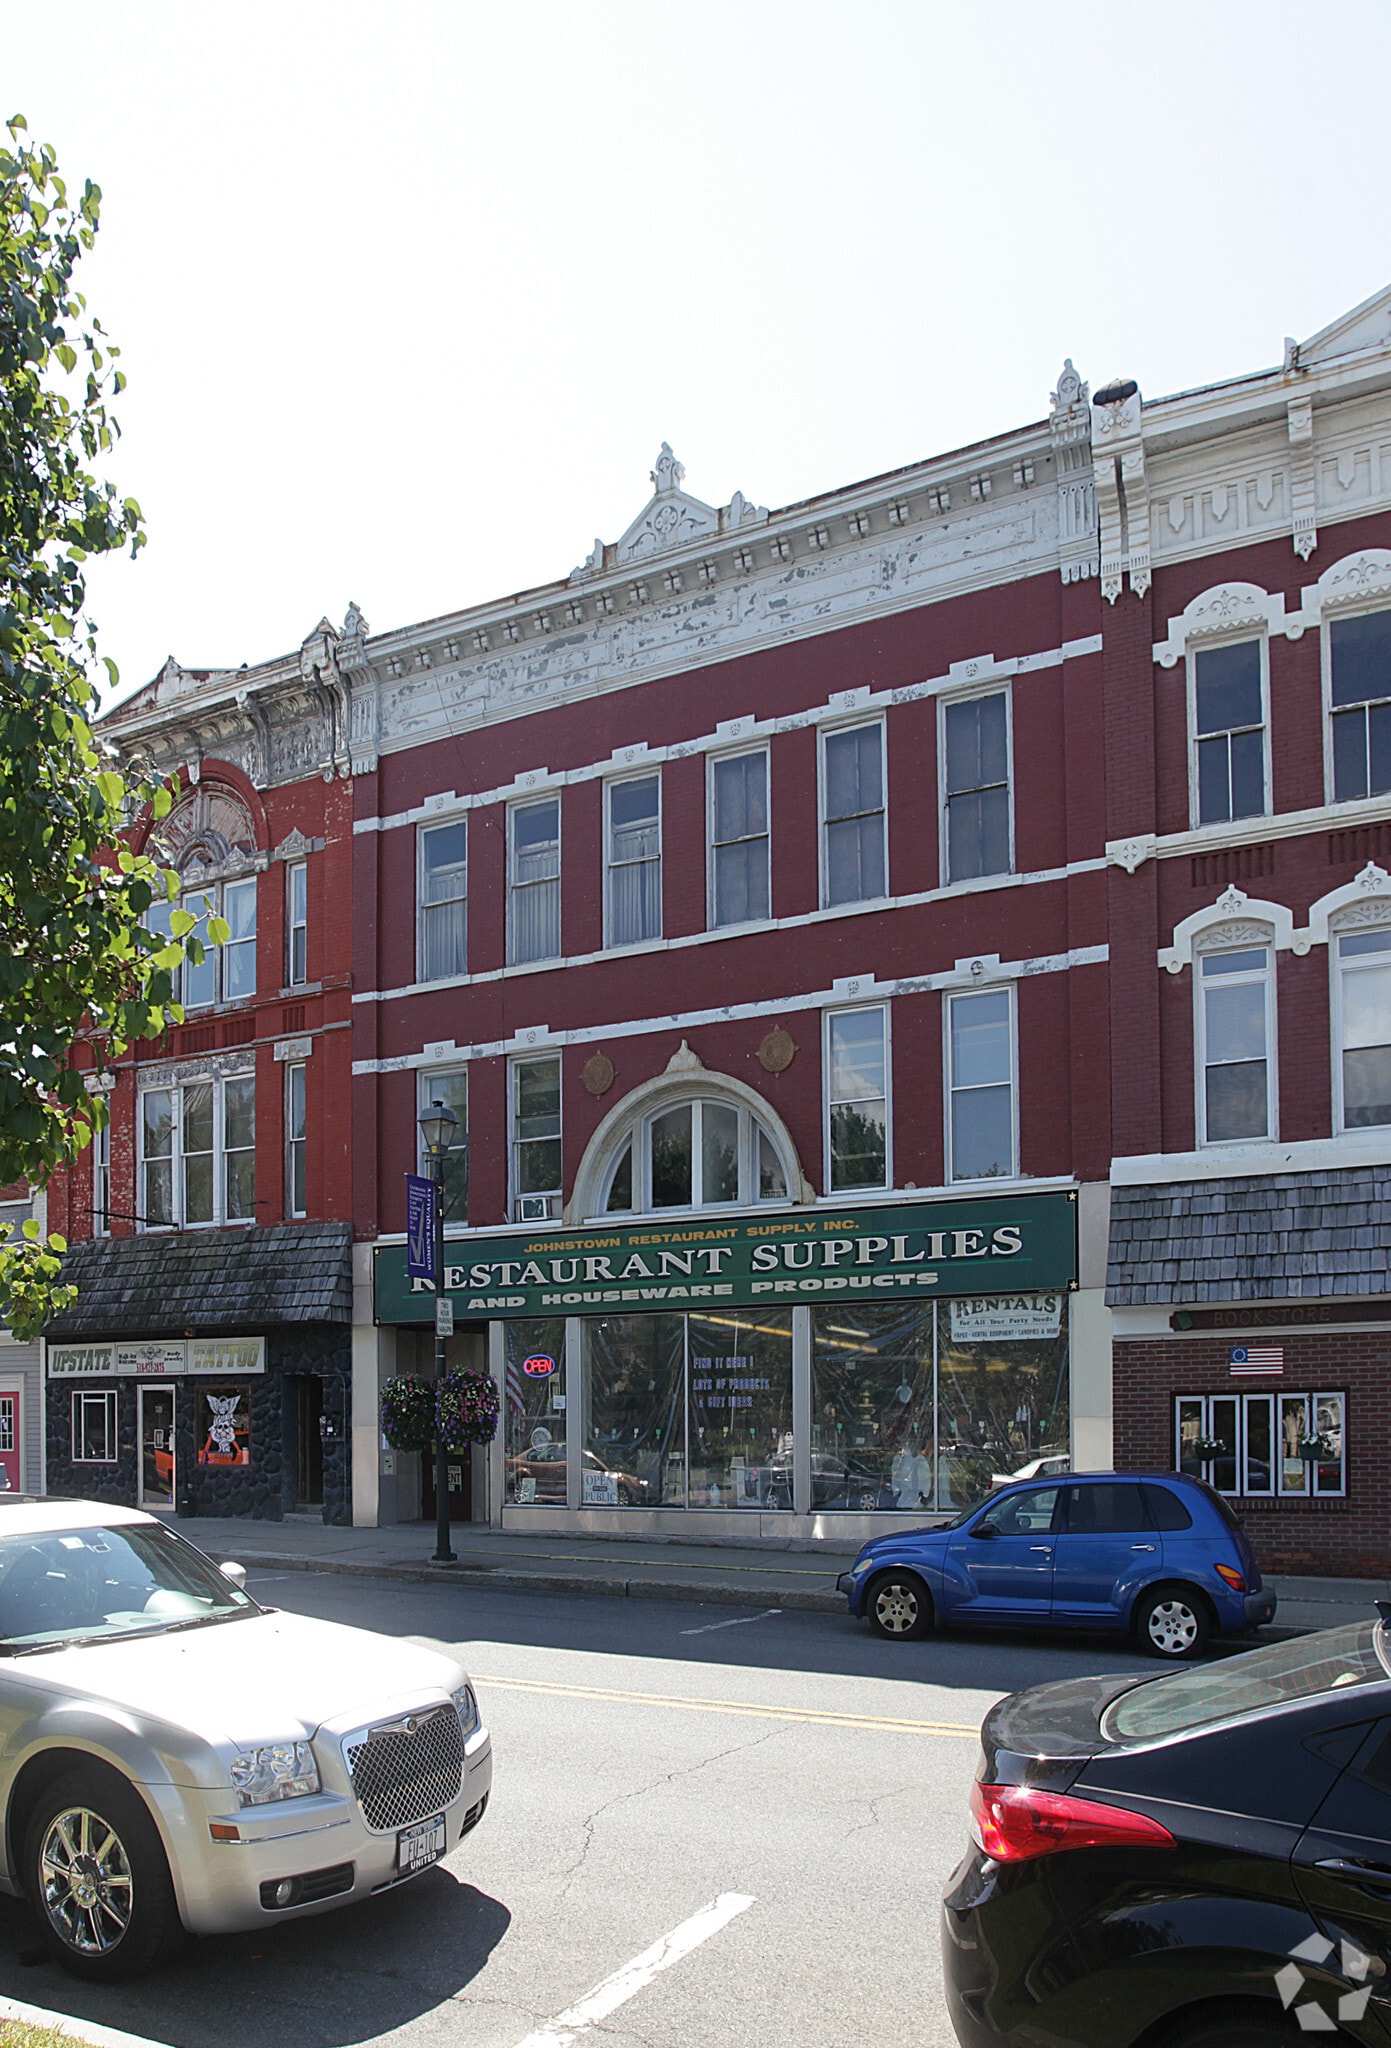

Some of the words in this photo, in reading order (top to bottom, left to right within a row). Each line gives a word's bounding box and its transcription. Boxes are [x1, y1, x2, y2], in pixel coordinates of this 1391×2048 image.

[524, 1238, 621, 1253] JOHNSTOWN
[629, 1229, 739, 1245] RESTAURANT
[746, 1223, 816, 1237] SUPPLY,
[824, 1219, 860, 1231] INC.
[425, 1232, 433, 1271] WOMEN'S
[751, 1226, 1023, 1271] SUPPLIES
[467, 1295, 526, 1310] AND
[542, 1284, 733, 1305] HOUSEWARE
[751, 1272, 939, 1294] PRODUCTS
[955, 1296, 1057, 1319] RENTALS
[1214, 1306, 1331, 1327] BOOKSTORE
[52, 1348, 112, 1372] UPSTATE
[193, 1344, 260, 1369] TATTOO
[525, 1359, 553, 1374] OPEN
[693, 1357, 712, 1369] FIND
[715, 1357, 724, 1369] IT
[726, 1356, 747, 1369] HERE
[693, 1379, 712, 1391] LOTS
[715, 1378, 726, 1390] OF
[728, 1378, 769, 1390] PRODUCTS
[707, 1396, 726, 1408] GIFT
[728, 1396, 753, 1408] IDEAS
[586, 1475, 614, 1486] OPEN
[585, 1491, 616, 1502] PUBLIC
[410, 1851, 437, 1870] UNITED
